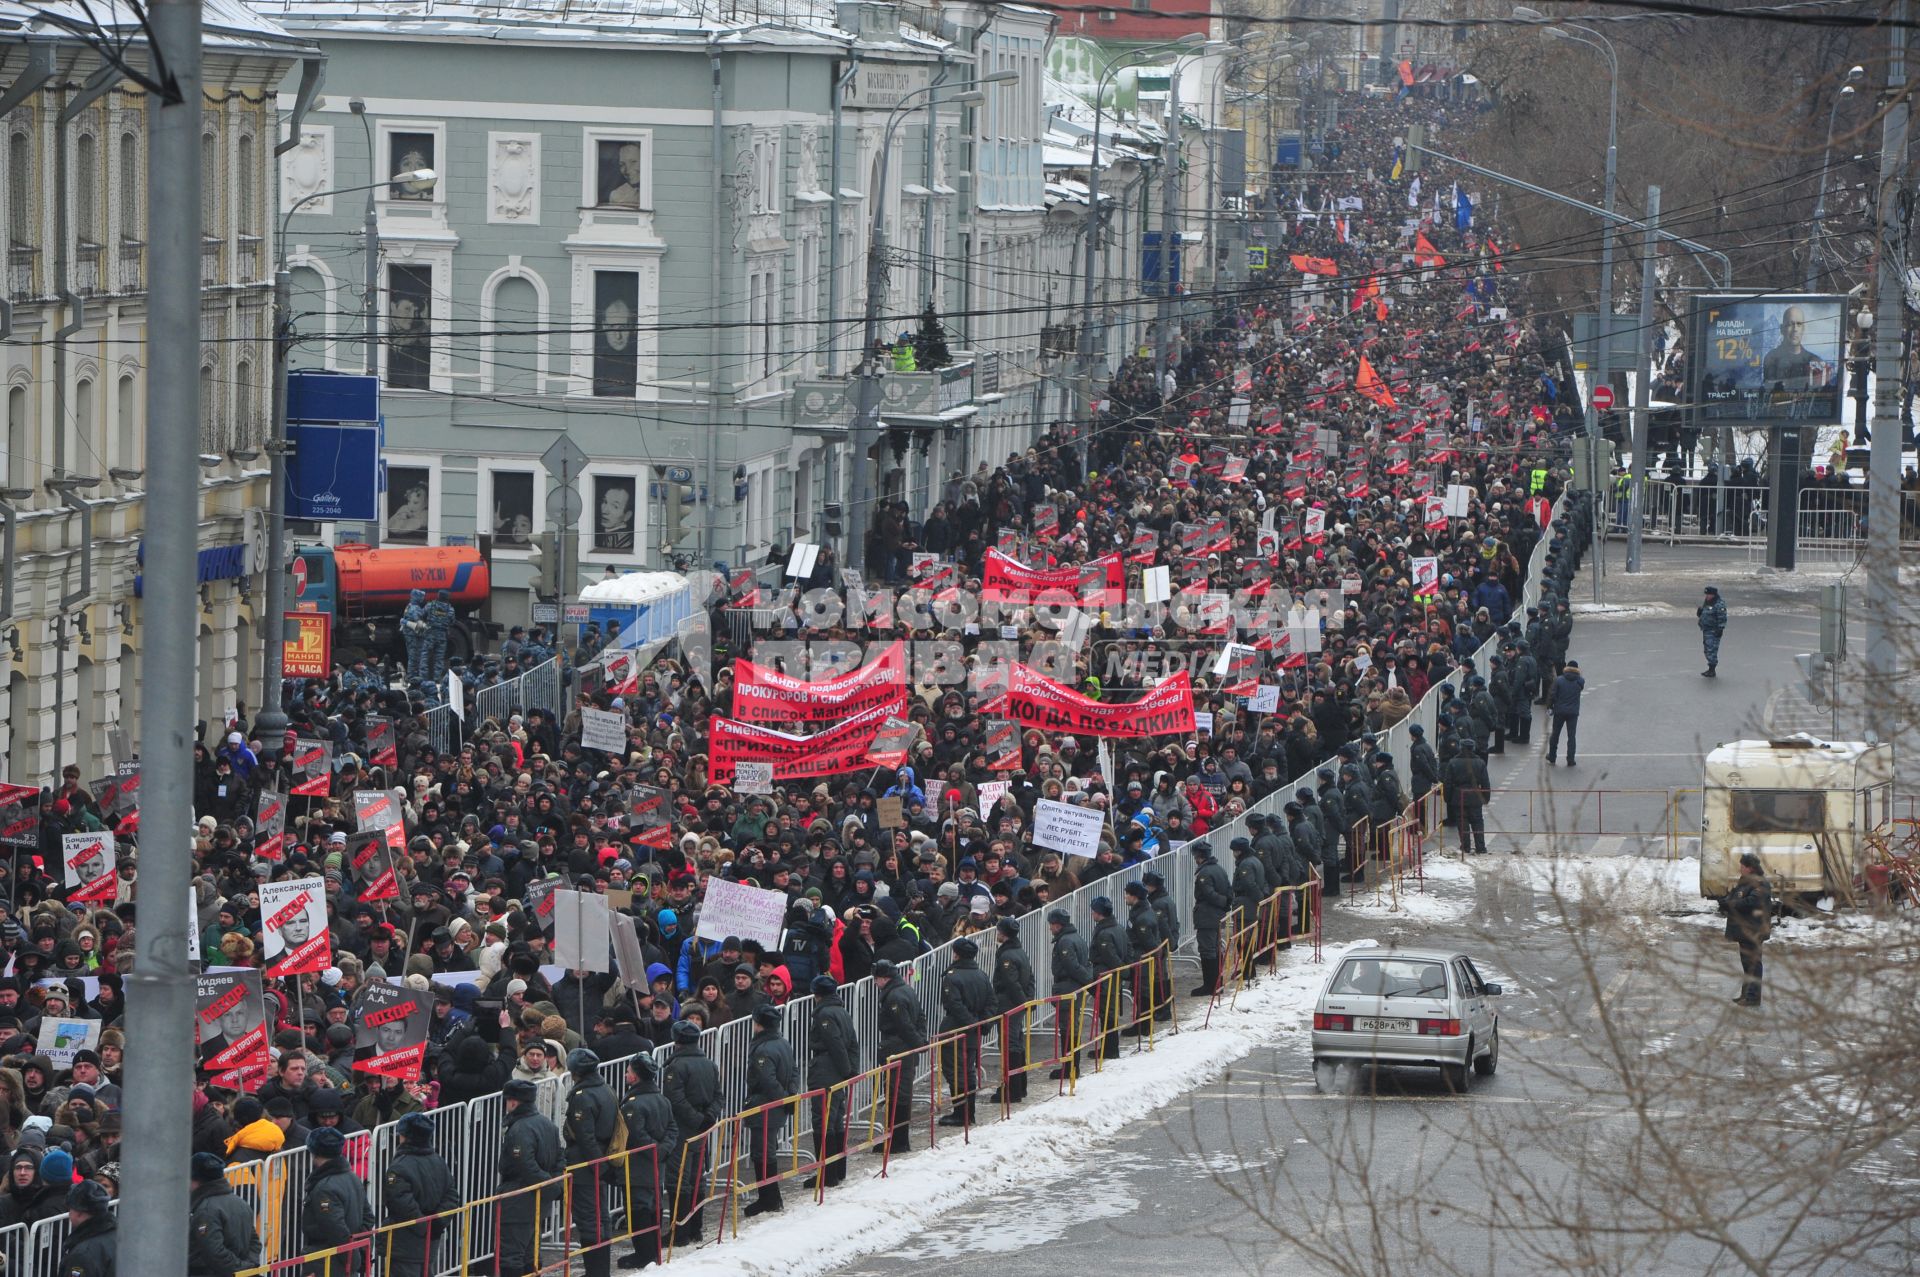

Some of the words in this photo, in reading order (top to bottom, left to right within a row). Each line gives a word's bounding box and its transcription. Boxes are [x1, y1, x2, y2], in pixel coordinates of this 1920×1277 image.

[1716, 320, 1745, 328] ВКЛАДЫ
[1716, 328, 1727, 336] НА
[1716, 336, 1753, 360] 12%
[312, 494, 341, 505] Gallery
[285, 664, 297, 673] 24
[298, 664, 323, 674] ЧАСА
[764, 673, 800, 689] БАНДУ
[737, 682, 808, 702] ПРОКУРОРОВ
[1257, 695, 1276, 710] НЕТ!
[1009, 699, 1073, 728] КОГДА
[774, 757, 839, 775] НАШЕЙ
[1041, 803, 1063, 814] Опять
[1063, 809, 1100, 821] актуально
[1058, 817, 1085, 828] России:
[1046, 824, 1059, 833] ЛЕС
[1060, 827, 1082, 837] РУБЯТ
[1042, 833, 1067, 843] ЩЕПКИ
[1066, 839, 1089, 849] ЛЕТЯТ
[66, 841, 105, 870] ПОЗОР!
[92, 874, 113, 888] ПРОТИВ
[262, 881, 323, 895] Александров
[528, 879, 563, 892] Харитонов
[262, 896, 281, 905] А.И.
[264, 890, 314, 933] ПОЗОР!
[792, 939, 807, 951] TV
[279, 952, 301, 971] МАРШ
[299, 936, 326, 958] ПРОТИВ
[196, 977, 234, 987] Кидяев
[197, 986, 219, 997] В.Б.
[368, 984, 399, 997] Агеев
[199, 982, 251, 1025] ПОЗОР!
[366, 993, 388, 1005] А.А.
[364, 999, 420, 1030] ПОЗОР!
[1397, 1020, 1410, 1029] 199
[36, 1049, 57, 1057] ПЕСЕЦ
[216, 1047, 239, 1065] МАРШ
[236, 1030, 263, 1051] ПРОТИВ
[367, 1056, 390, 1069] МАРШ
[390, 1047, 420, 1062] ПРОТИВ
